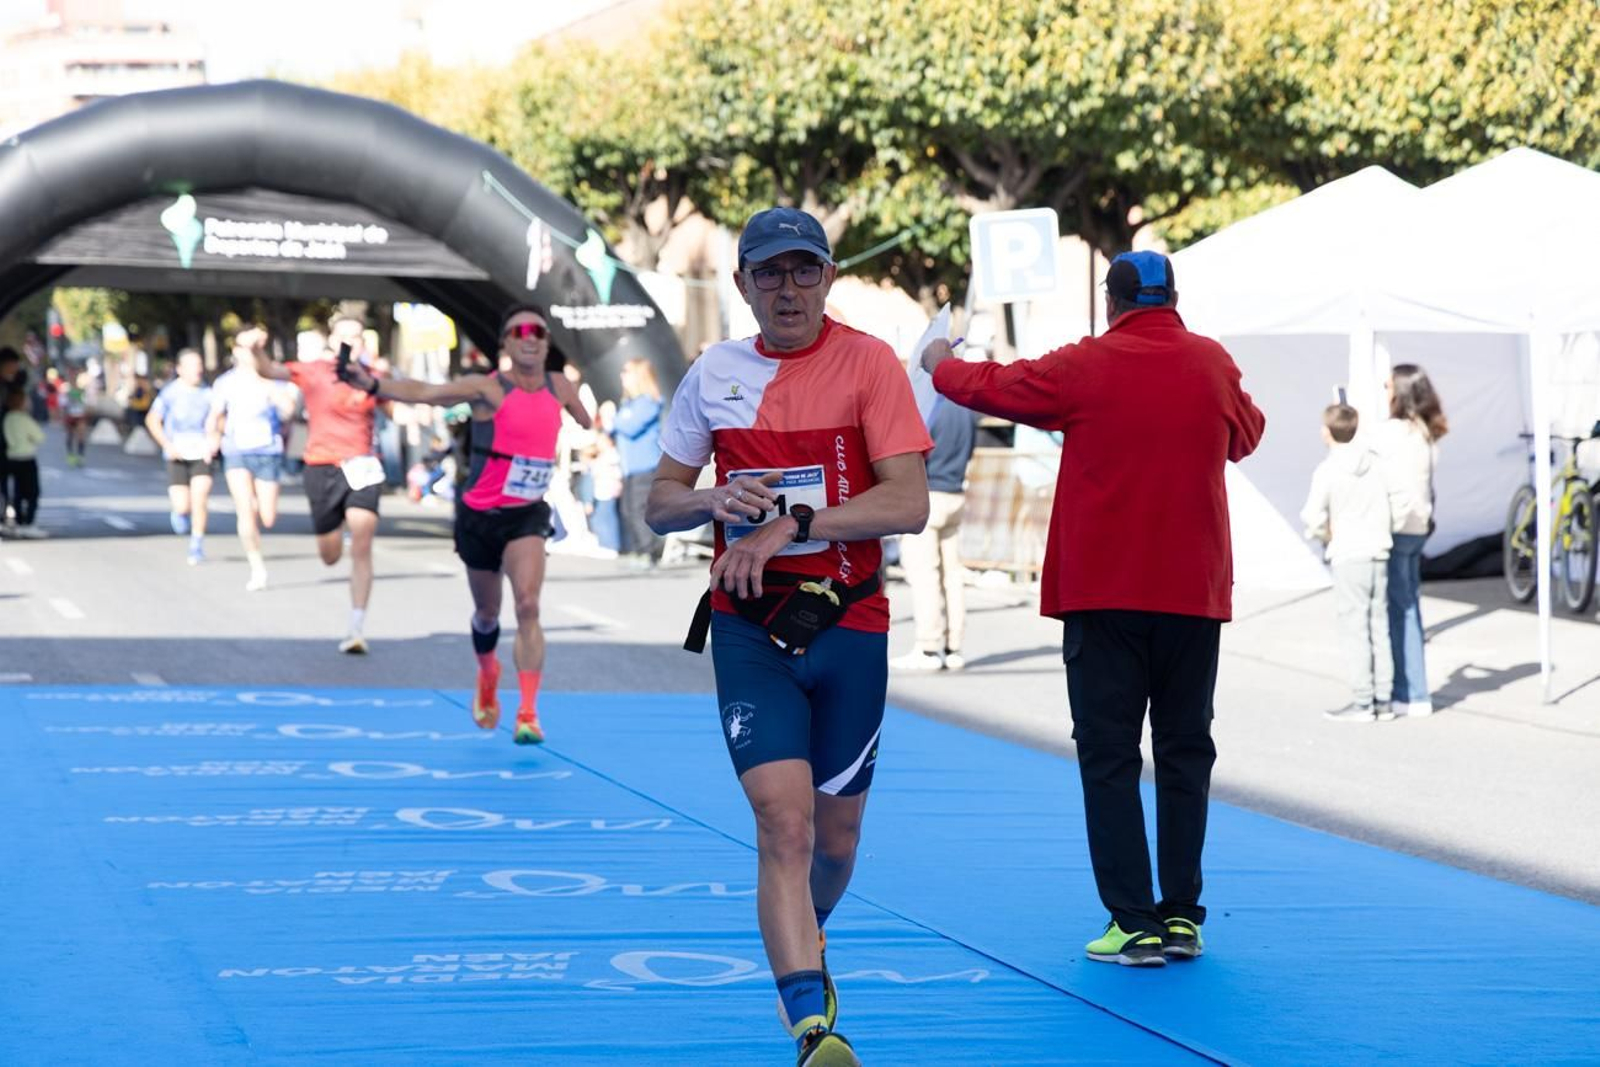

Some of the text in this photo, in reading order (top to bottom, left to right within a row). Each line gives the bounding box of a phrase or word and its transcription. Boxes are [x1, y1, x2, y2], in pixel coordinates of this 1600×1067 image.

[989, 220, 1042, 294] P
[835, 435, 848, 471] CLUB
[333, 971, 565, 985] MEDIA
